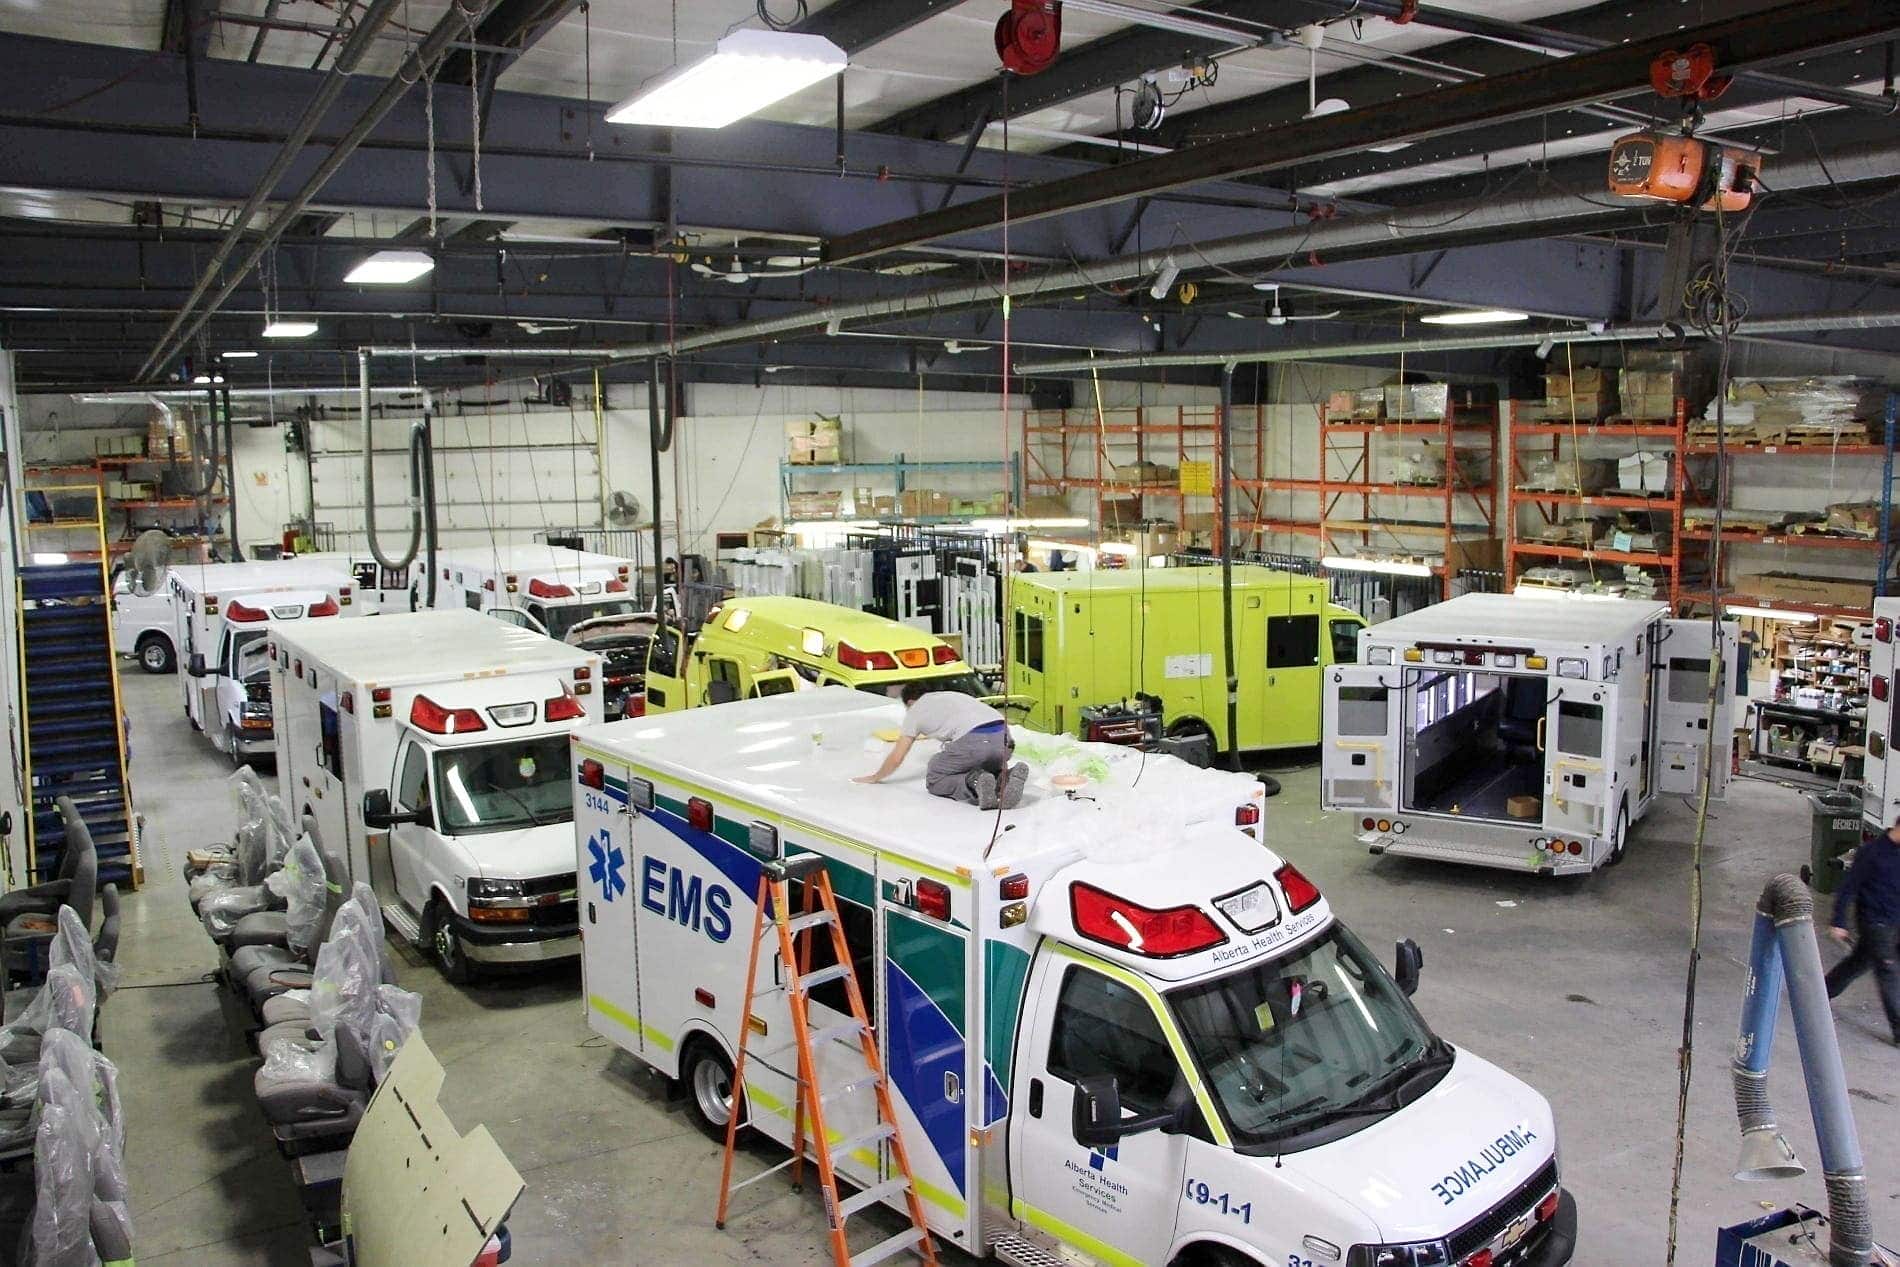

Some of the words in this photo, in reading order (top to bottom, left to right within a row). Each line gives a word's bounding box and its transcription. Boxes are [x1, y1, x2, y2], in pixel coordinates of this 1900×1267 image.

[585, 793, 609, 815] 3144
[641, 854, 732, 943] EMS
[1212, 944, 1250, 963] Alberta
[1252, 930, 1284, 950] Health
[1285, 913, 1315, 935] Services
[1064, 1159, 1096, 1180] Alberta
[1099, 1175, 1128, 1196] Health
[1079, 1178, 1116, 1202] Services
[1195, 1182, 1253, 1225] 9-1-1
